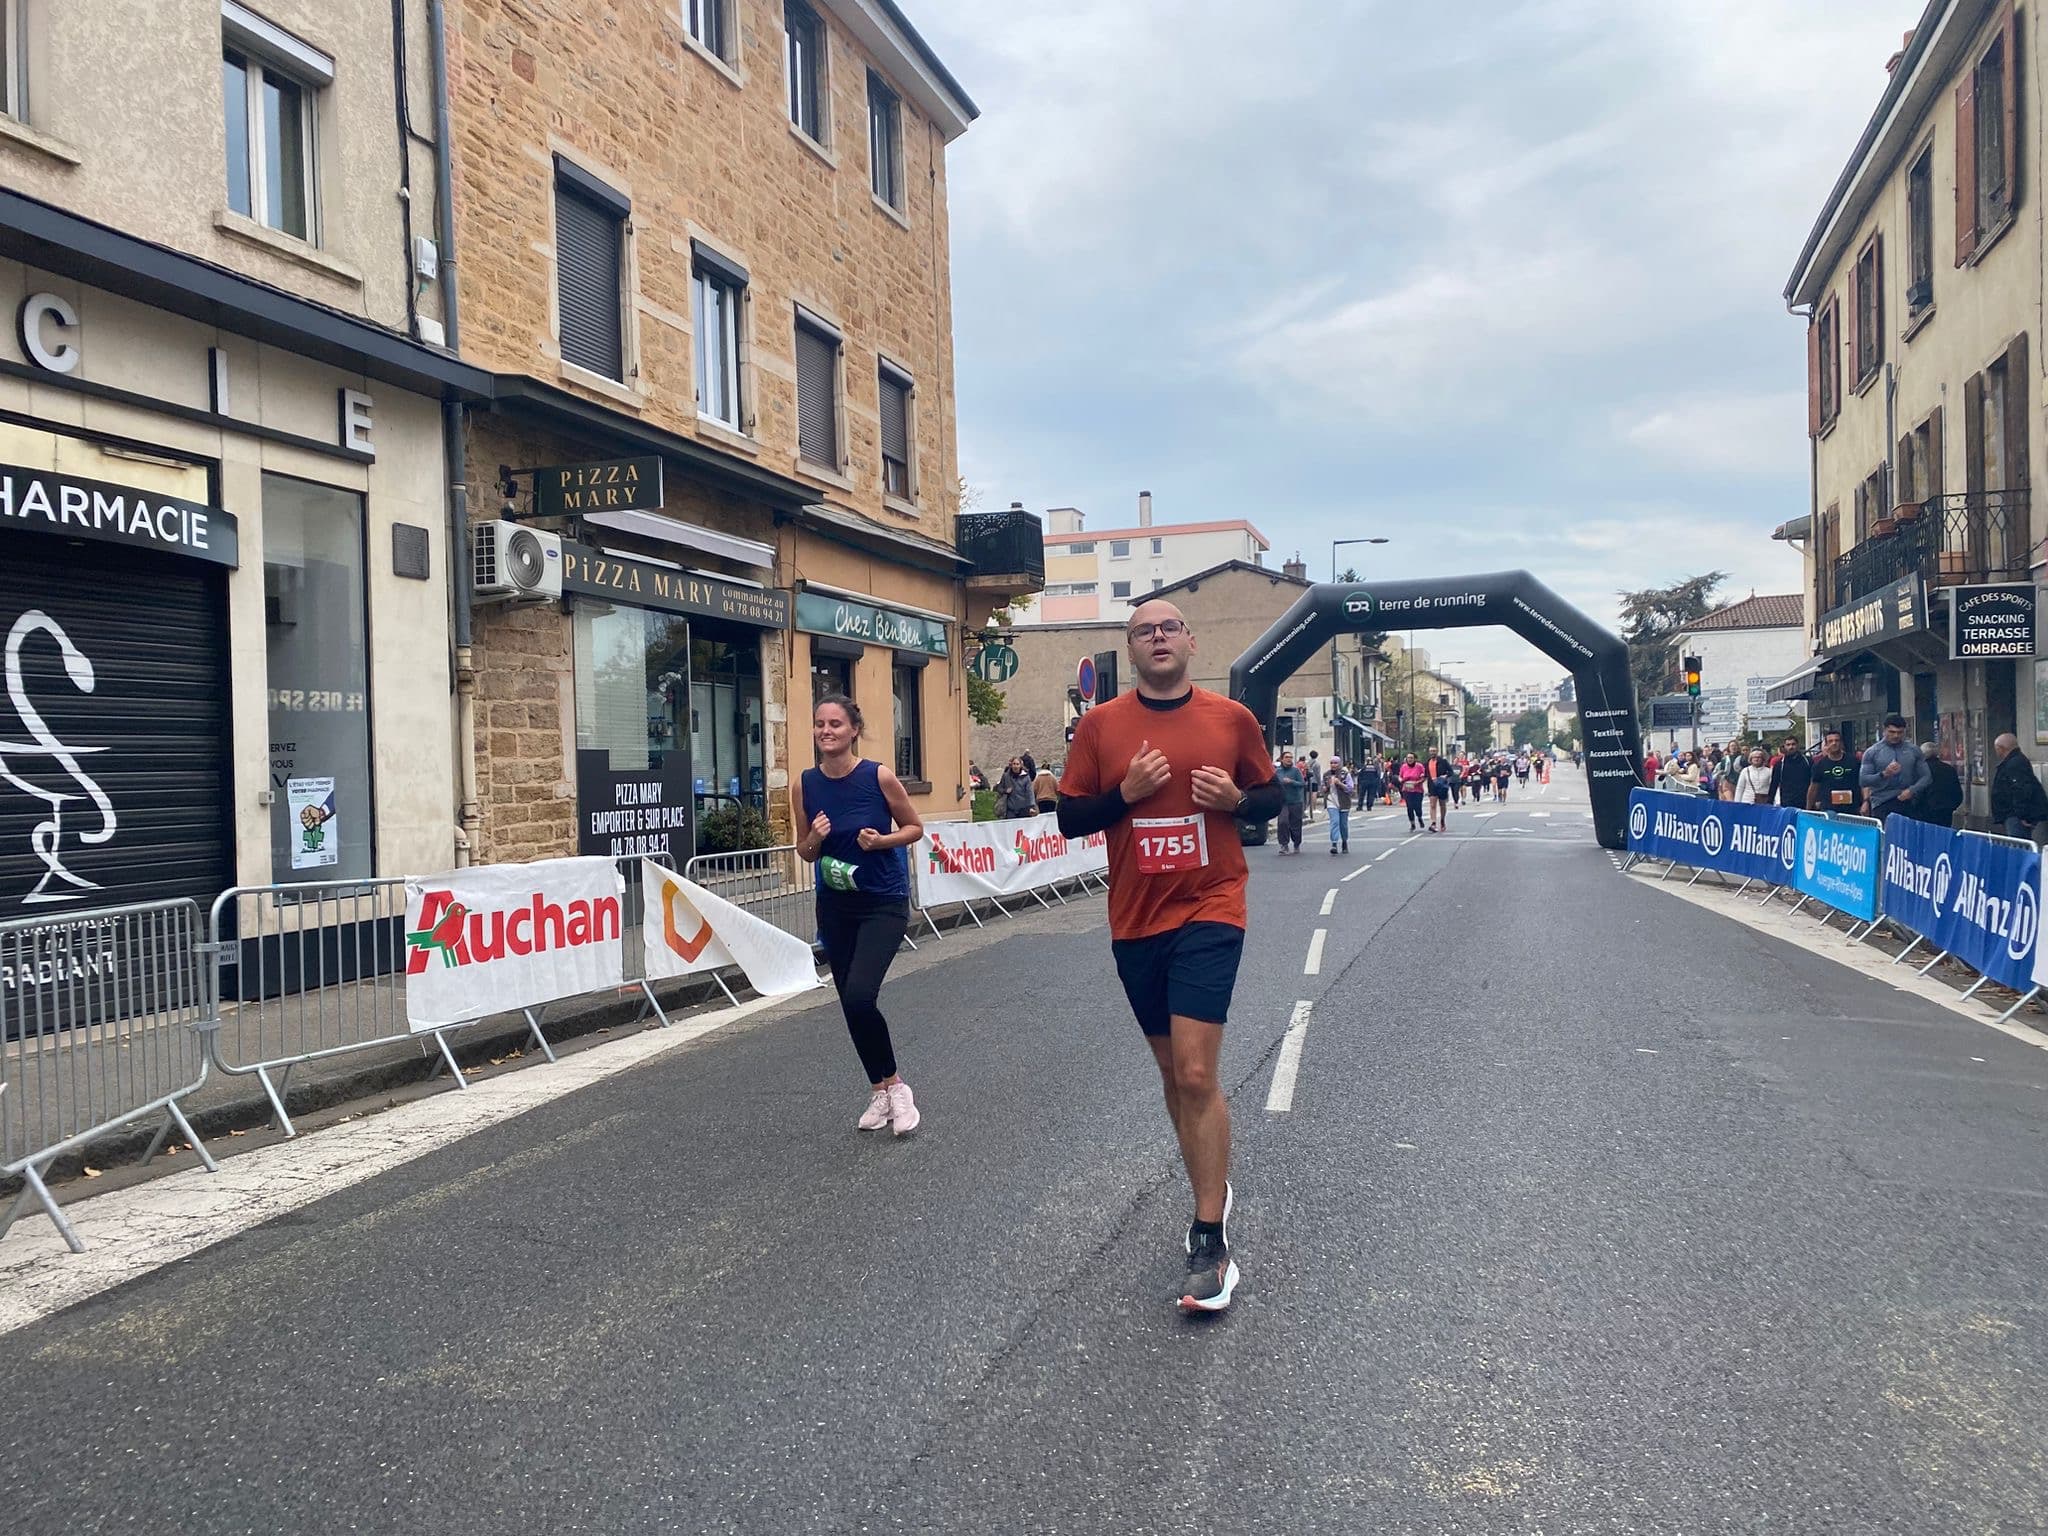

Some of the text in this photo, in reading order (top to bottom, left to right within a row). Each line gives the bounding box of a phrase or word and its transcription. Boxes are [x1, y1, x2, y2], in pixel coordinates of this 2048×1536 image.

[564, 486, 637, 509] MARY
[654, 573, 713, 606] MARY
[722, 585, 784, 609] Commandez au
[723, 600, 783, 623] 04 78 08 94 21
[1379, 593, 1486, 611] terre de running
[1958, 592, 2034, 613] CAFE DES SPORTS
[835, 604, 871, 636] Chez
[1513, 596, 1594, 658] www.terrederunning.com
[1968, 614, 2025, 625] SNACKING
[1962, 627, 2031, 640] TERRASSE
[1961, 642, 2034, 655] OMBRAGEE
[1585, 709, 1629, 718] Chaussures
[1592, 729, 1625, 738] Textiles
[270, 759, 294, 769] VOUS
[1589, 749, 1633, 757] Accessoires
[615, 782, 663, 806] PIZZA MARY
[591, 806, 685, 835] EMPORTER & SUR PLACE
[1654, 810, 1699, 845] Allianz
[1139, 834, 1196, 857] 1755
[1730, 823, 1780, 859] Allianz
[1818, 829, 1867, 876] La Région
[1885, 844, 1932, 899] Allianz
[407, 889, 620, 975] Auchan
